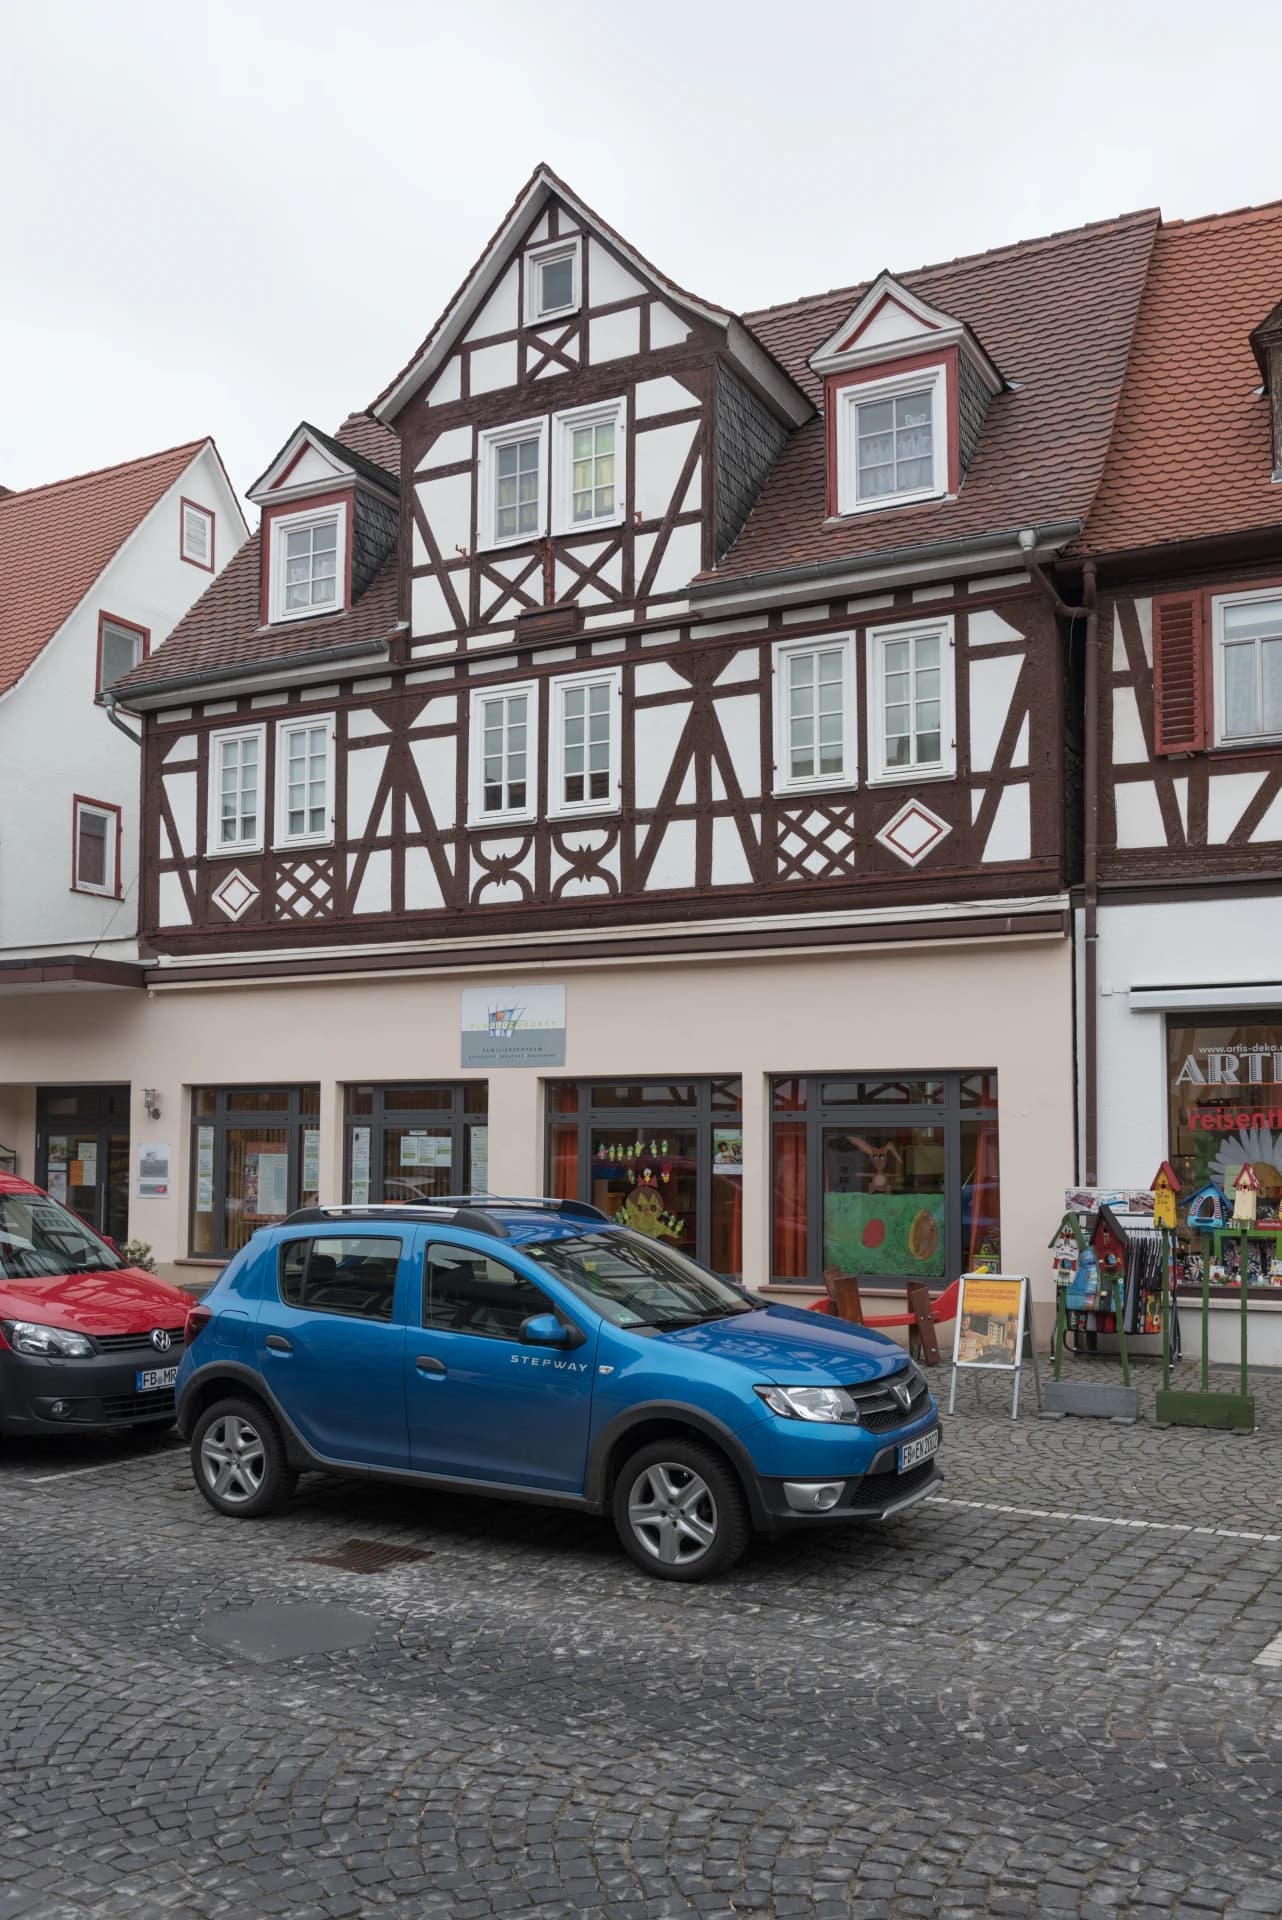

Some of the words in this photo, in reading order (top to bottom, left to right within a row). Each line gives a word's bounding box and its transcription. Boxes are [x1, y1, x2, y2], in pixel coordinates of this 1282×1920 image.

[1198, 1043, 1282, 1054] www.artis-deko.
[510, 1354, 589, 1373] STEPWAY
[143, 1372, 157, 1388] FB
[903, 1446, 912, 1466] FB
